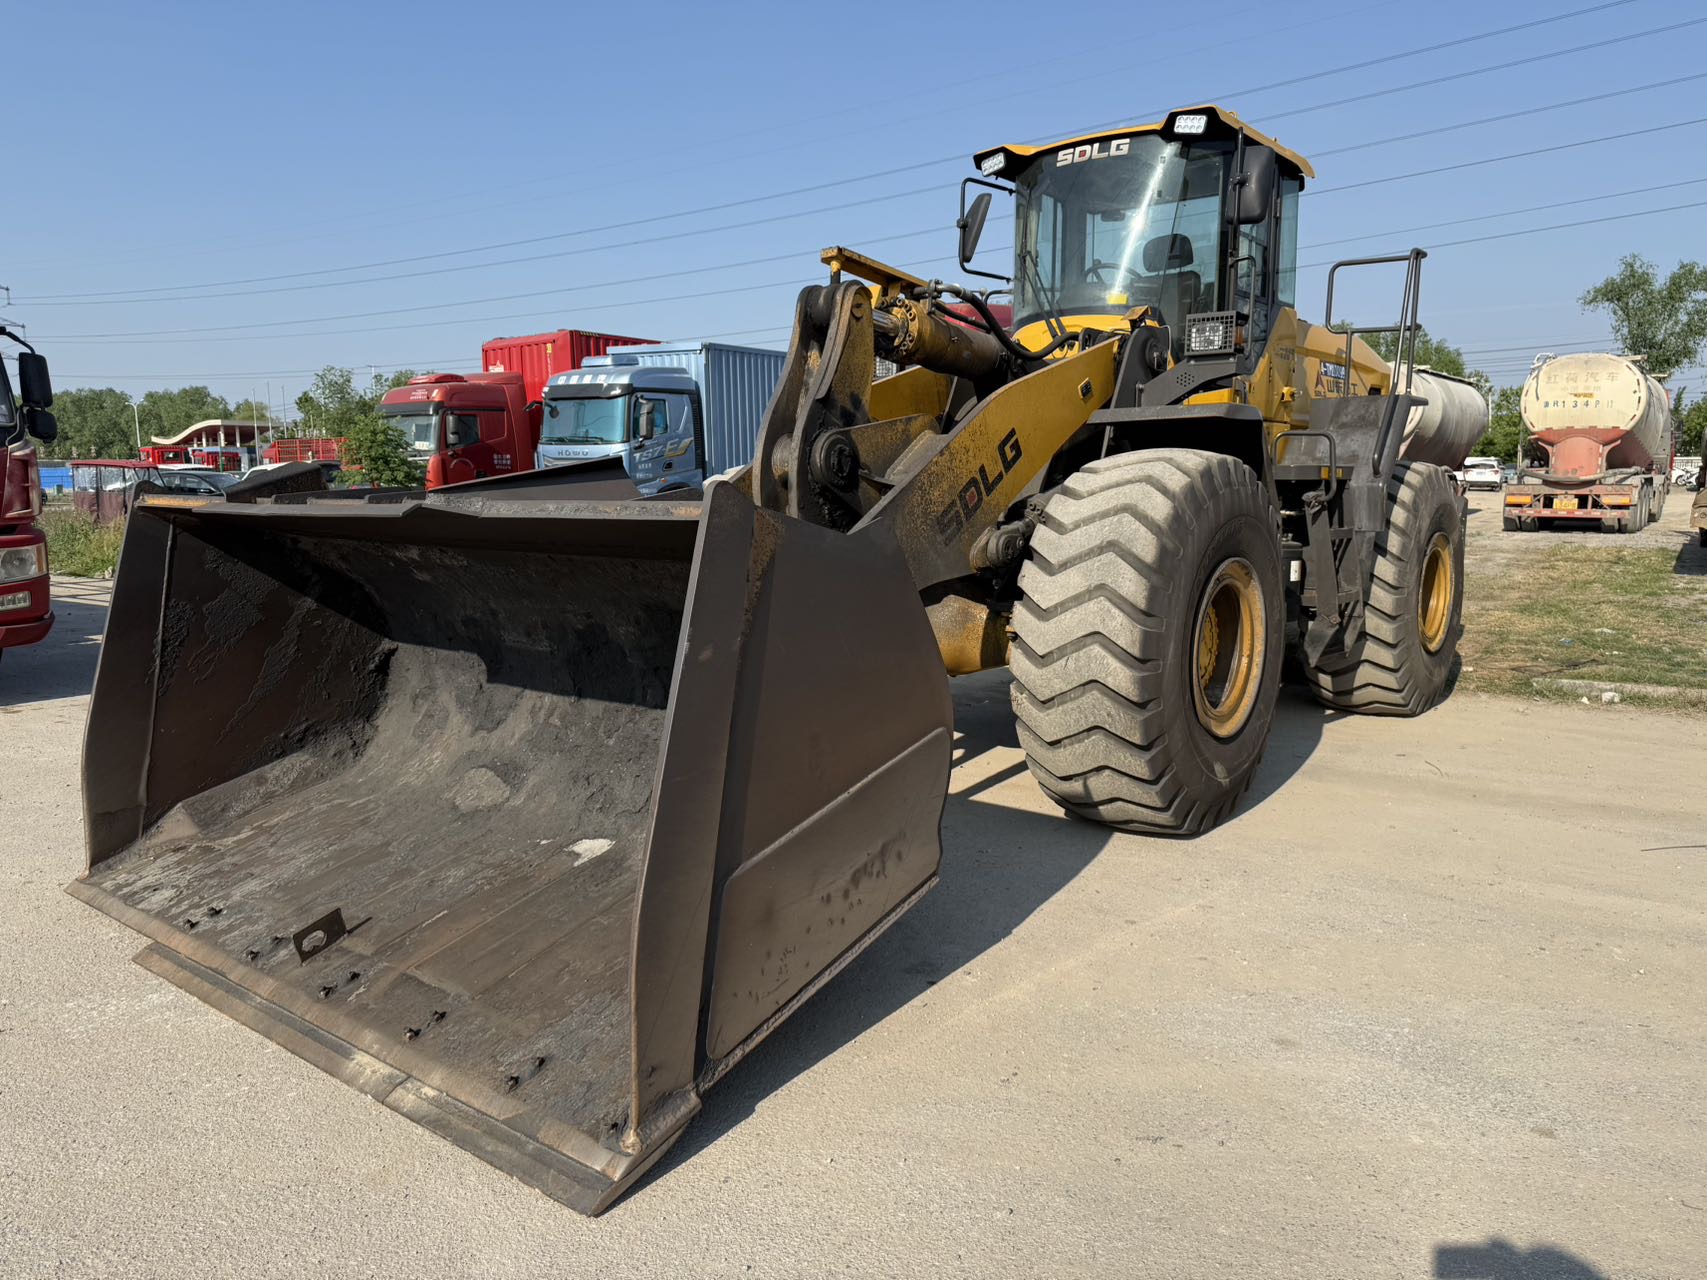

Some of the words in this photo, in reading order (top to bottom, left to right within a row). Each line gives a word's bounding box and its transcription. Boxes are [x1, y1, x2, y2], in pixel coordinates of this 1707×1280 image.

[1056, 138, 1130, 168] SDLG
[558, 449, 589, 457] HOWO
[938, 427, 1022, 546] SDLG
